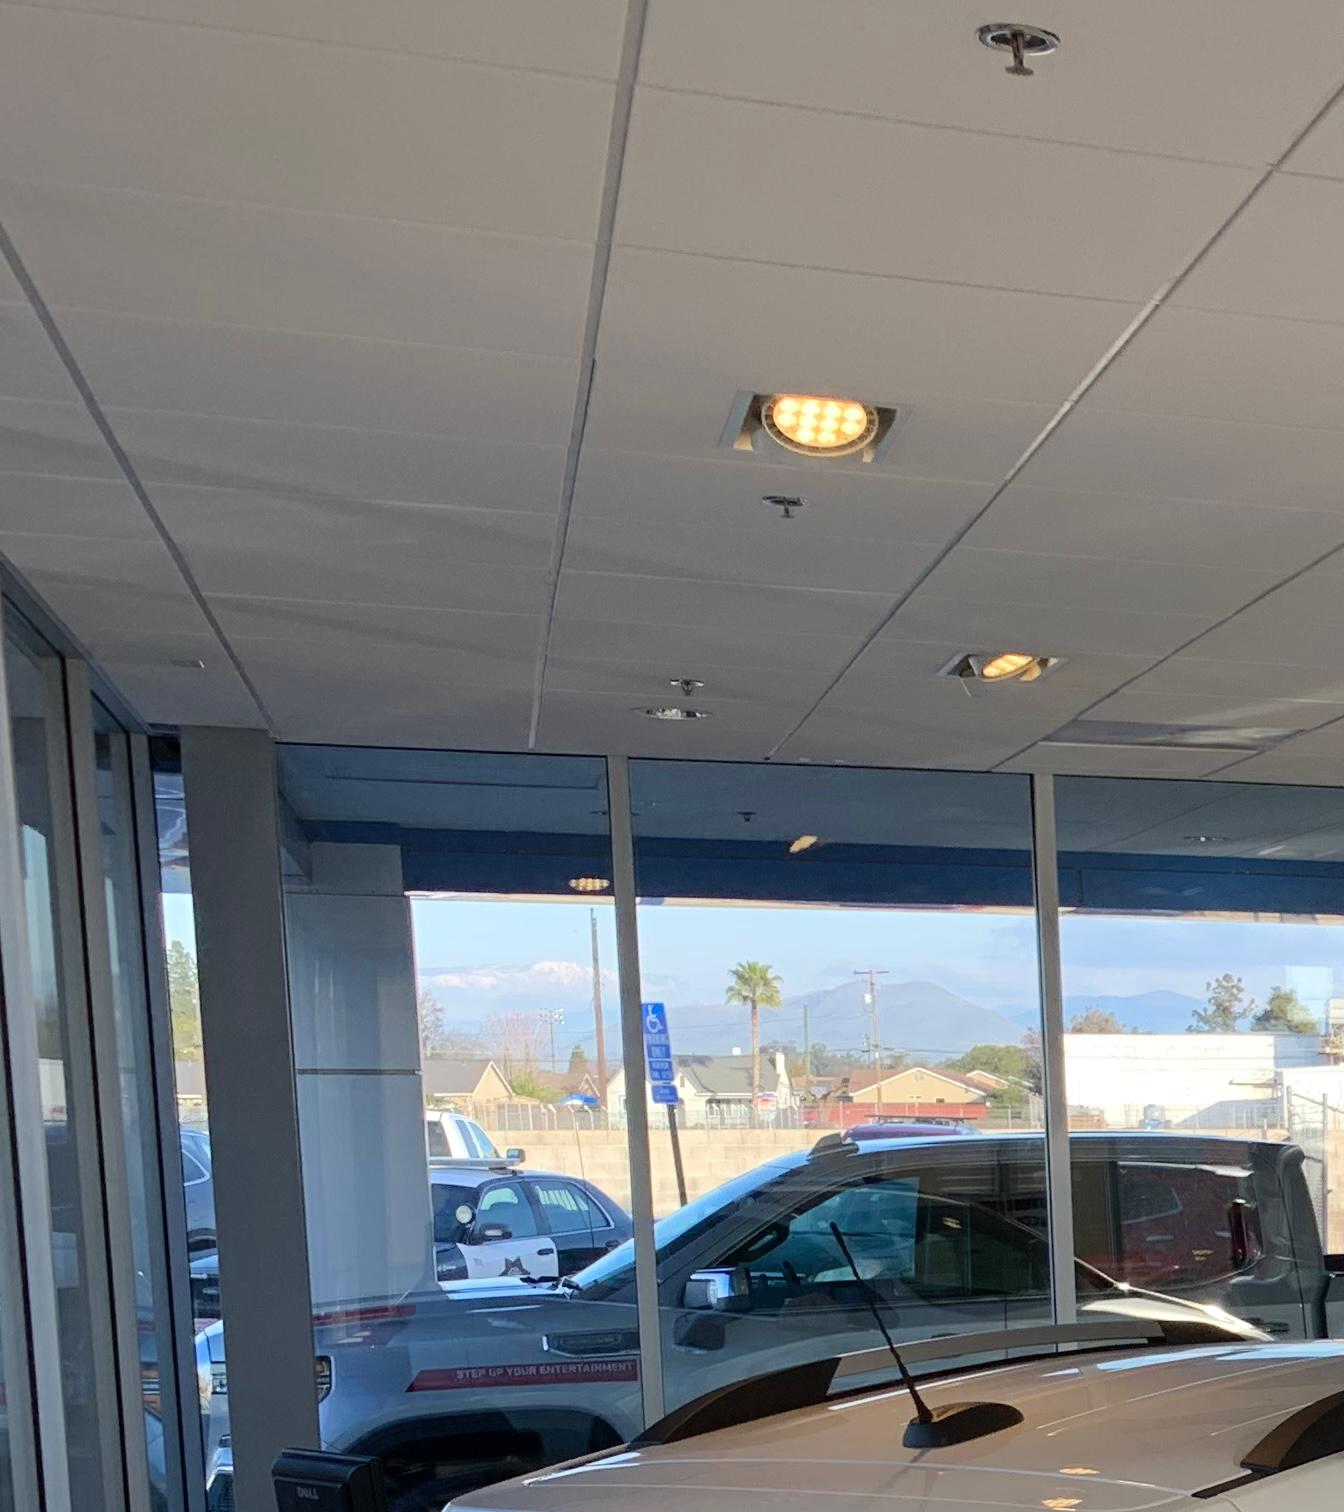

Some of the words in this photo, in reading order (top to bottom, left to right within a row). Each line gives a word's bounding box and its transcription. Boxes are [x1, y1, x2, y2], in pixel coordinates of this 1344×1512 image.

[456, 1369, 487, 1380] STEP
[489, 1368, 505, 1378] UP
[506, 1366, 538, 1377] YOUR
[539, 1362, 633, 1376] ENTERTAINMENT
[296, 1486, 320, 1500] DELL
